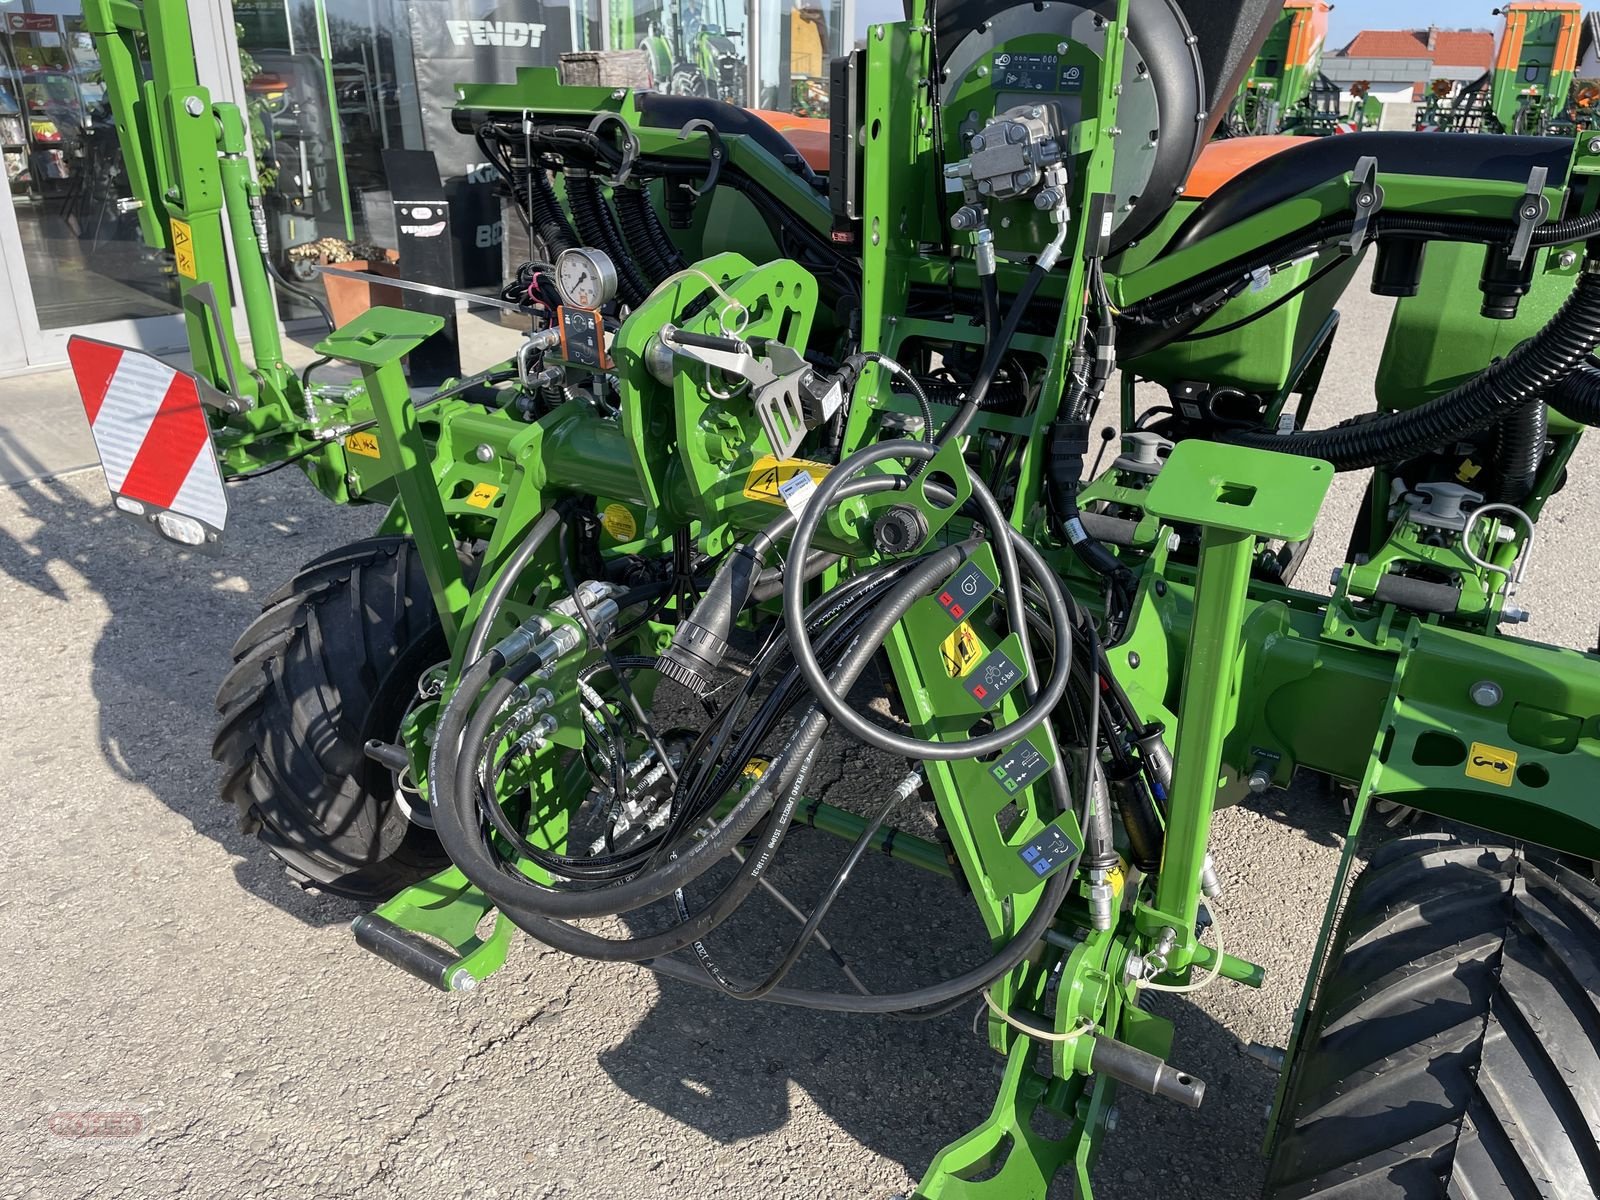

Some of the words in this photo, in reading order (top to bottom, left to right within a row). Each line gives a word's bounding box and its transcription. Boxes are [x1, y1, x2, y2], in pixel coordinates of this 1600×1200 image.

[445, 20, 547, 48] FENDT
[1004, 670, 1015, 680] bar
[801, 765, 808, 773] IN
[791, 774, 805, 796] POLAND
